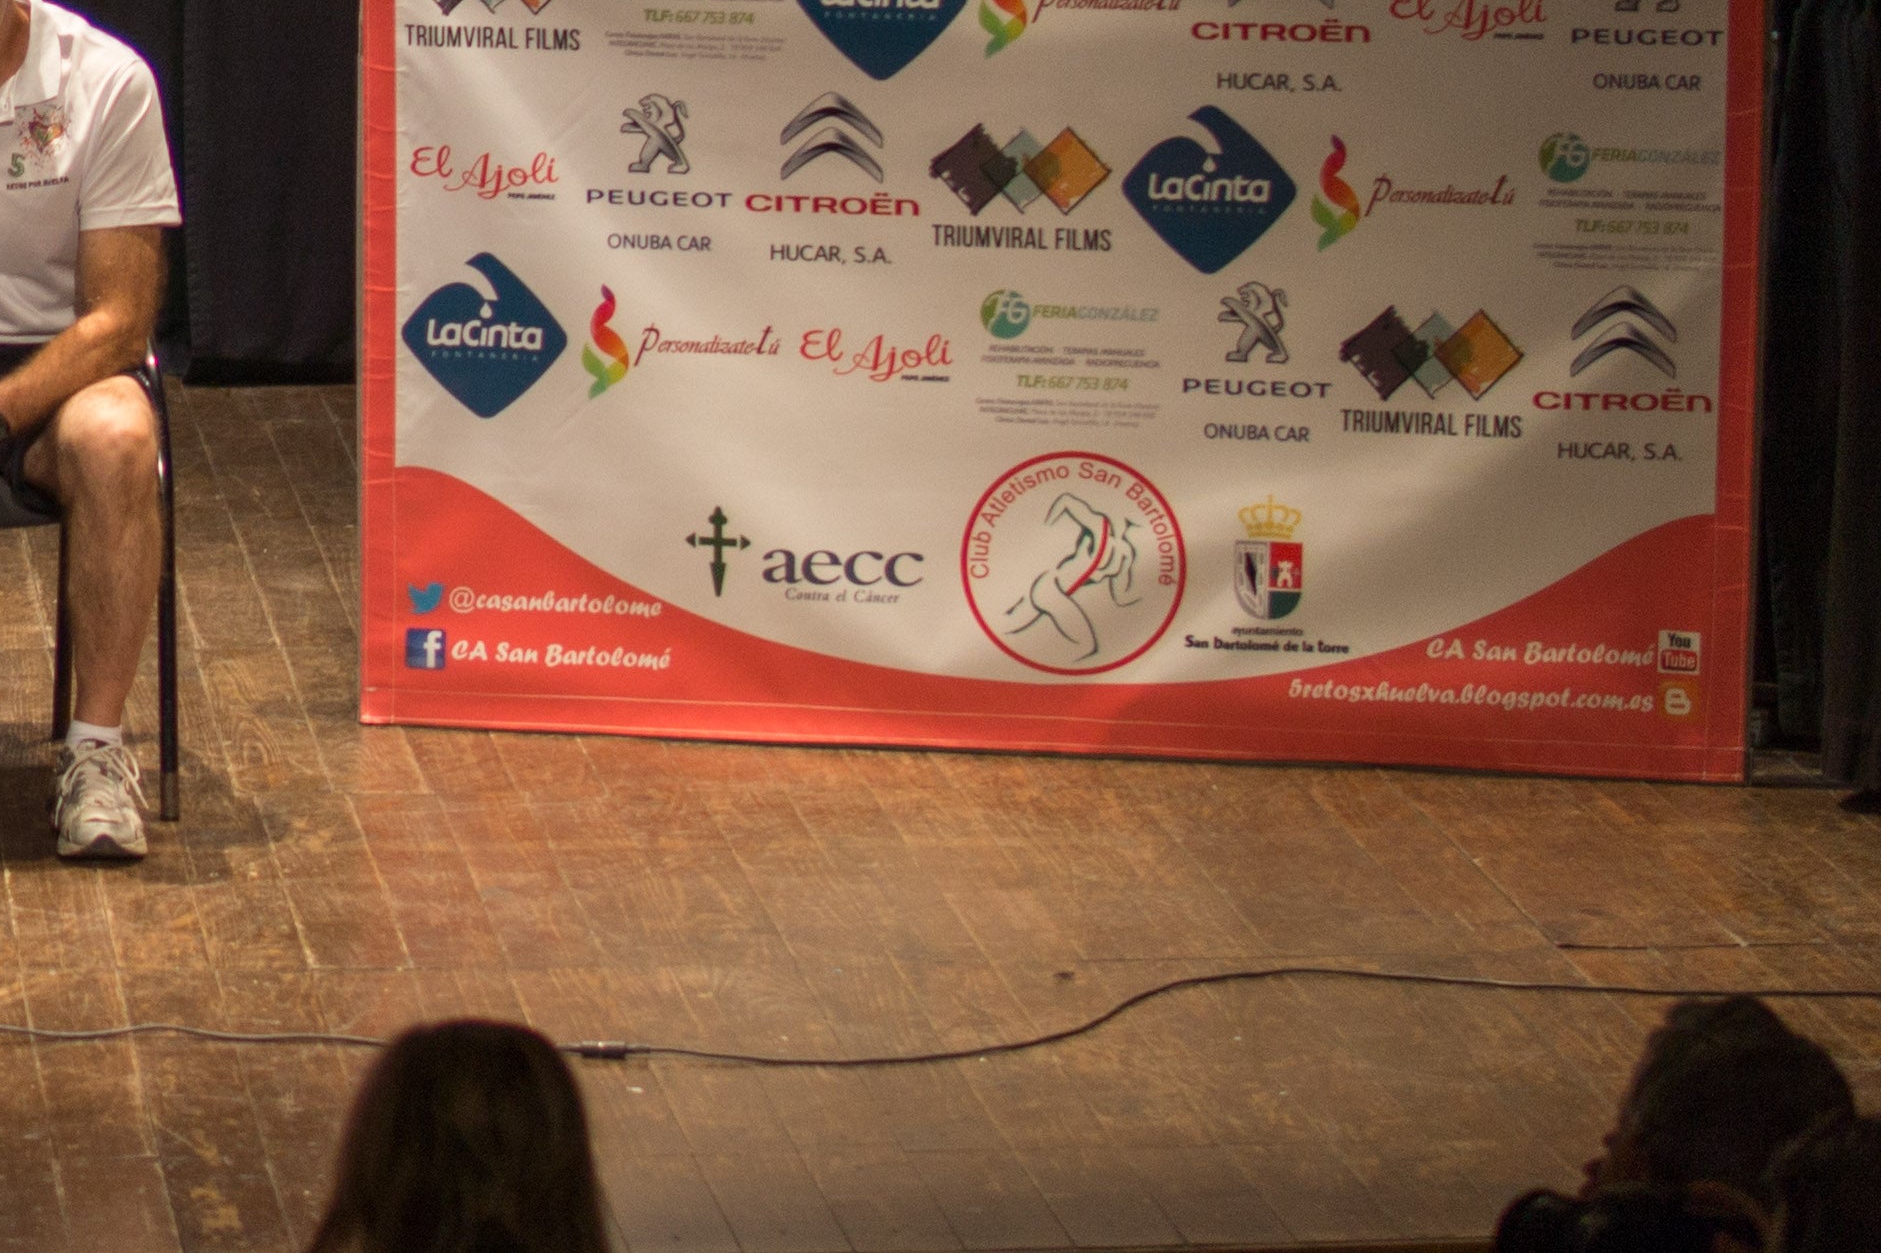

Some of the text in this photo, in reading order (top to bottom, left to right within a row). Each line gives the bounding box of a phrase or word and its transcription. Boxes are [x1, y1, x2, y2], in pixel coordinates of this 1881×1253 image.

[404, 24, 520, 50] TRIUMVIRAL
[525, 27, 582, 52] FILMS
[1570, 27, 1725, 47] PEUGEOT
[1216, 72, 1342, 92] HUCAR, S.A.
[1592, 73, 1702, 91] ONUBA CAR
[410, 145, 453, 180] El
[586, 188, 733, 209] PEUGEOT
[607, 233, 712, 251] ONUBA CAR
[932, 223, 1112, 252] TRIUMVIRAL FILMS
[770, 243, 892, 265] HUCAR, S.A.
[800, 328, 844, 363] El
[1182, 378, 1333, 399] PEUGEOT
[1203, 422, 1310, 443] ONUBA CAR
[1339, 409, 1522, 438] TRIUMVIRAL FILMS
[1557, 442, 1683, 462] HUCAR, S.A.
[970, 461, 1178, 587] Club Atletismo San Bartolomé
[761, 547, 925, 587] aecc
[448, 586, 663, 618] @casanbartolome
[784, 587, 901, 605] Contra el Cáncer
[1184, 634, 1210, 650] San
[1283, 639, 1299, 652] de
[1302, 640, 1314, 653] la
[1668, 632, 1692, 649] You
[451, 639, 672, 670] CA San Bartolomé
[1425, 638, 1654, 667] CA San Bartolomé
[1664, 651, 1697, 668] Tube
